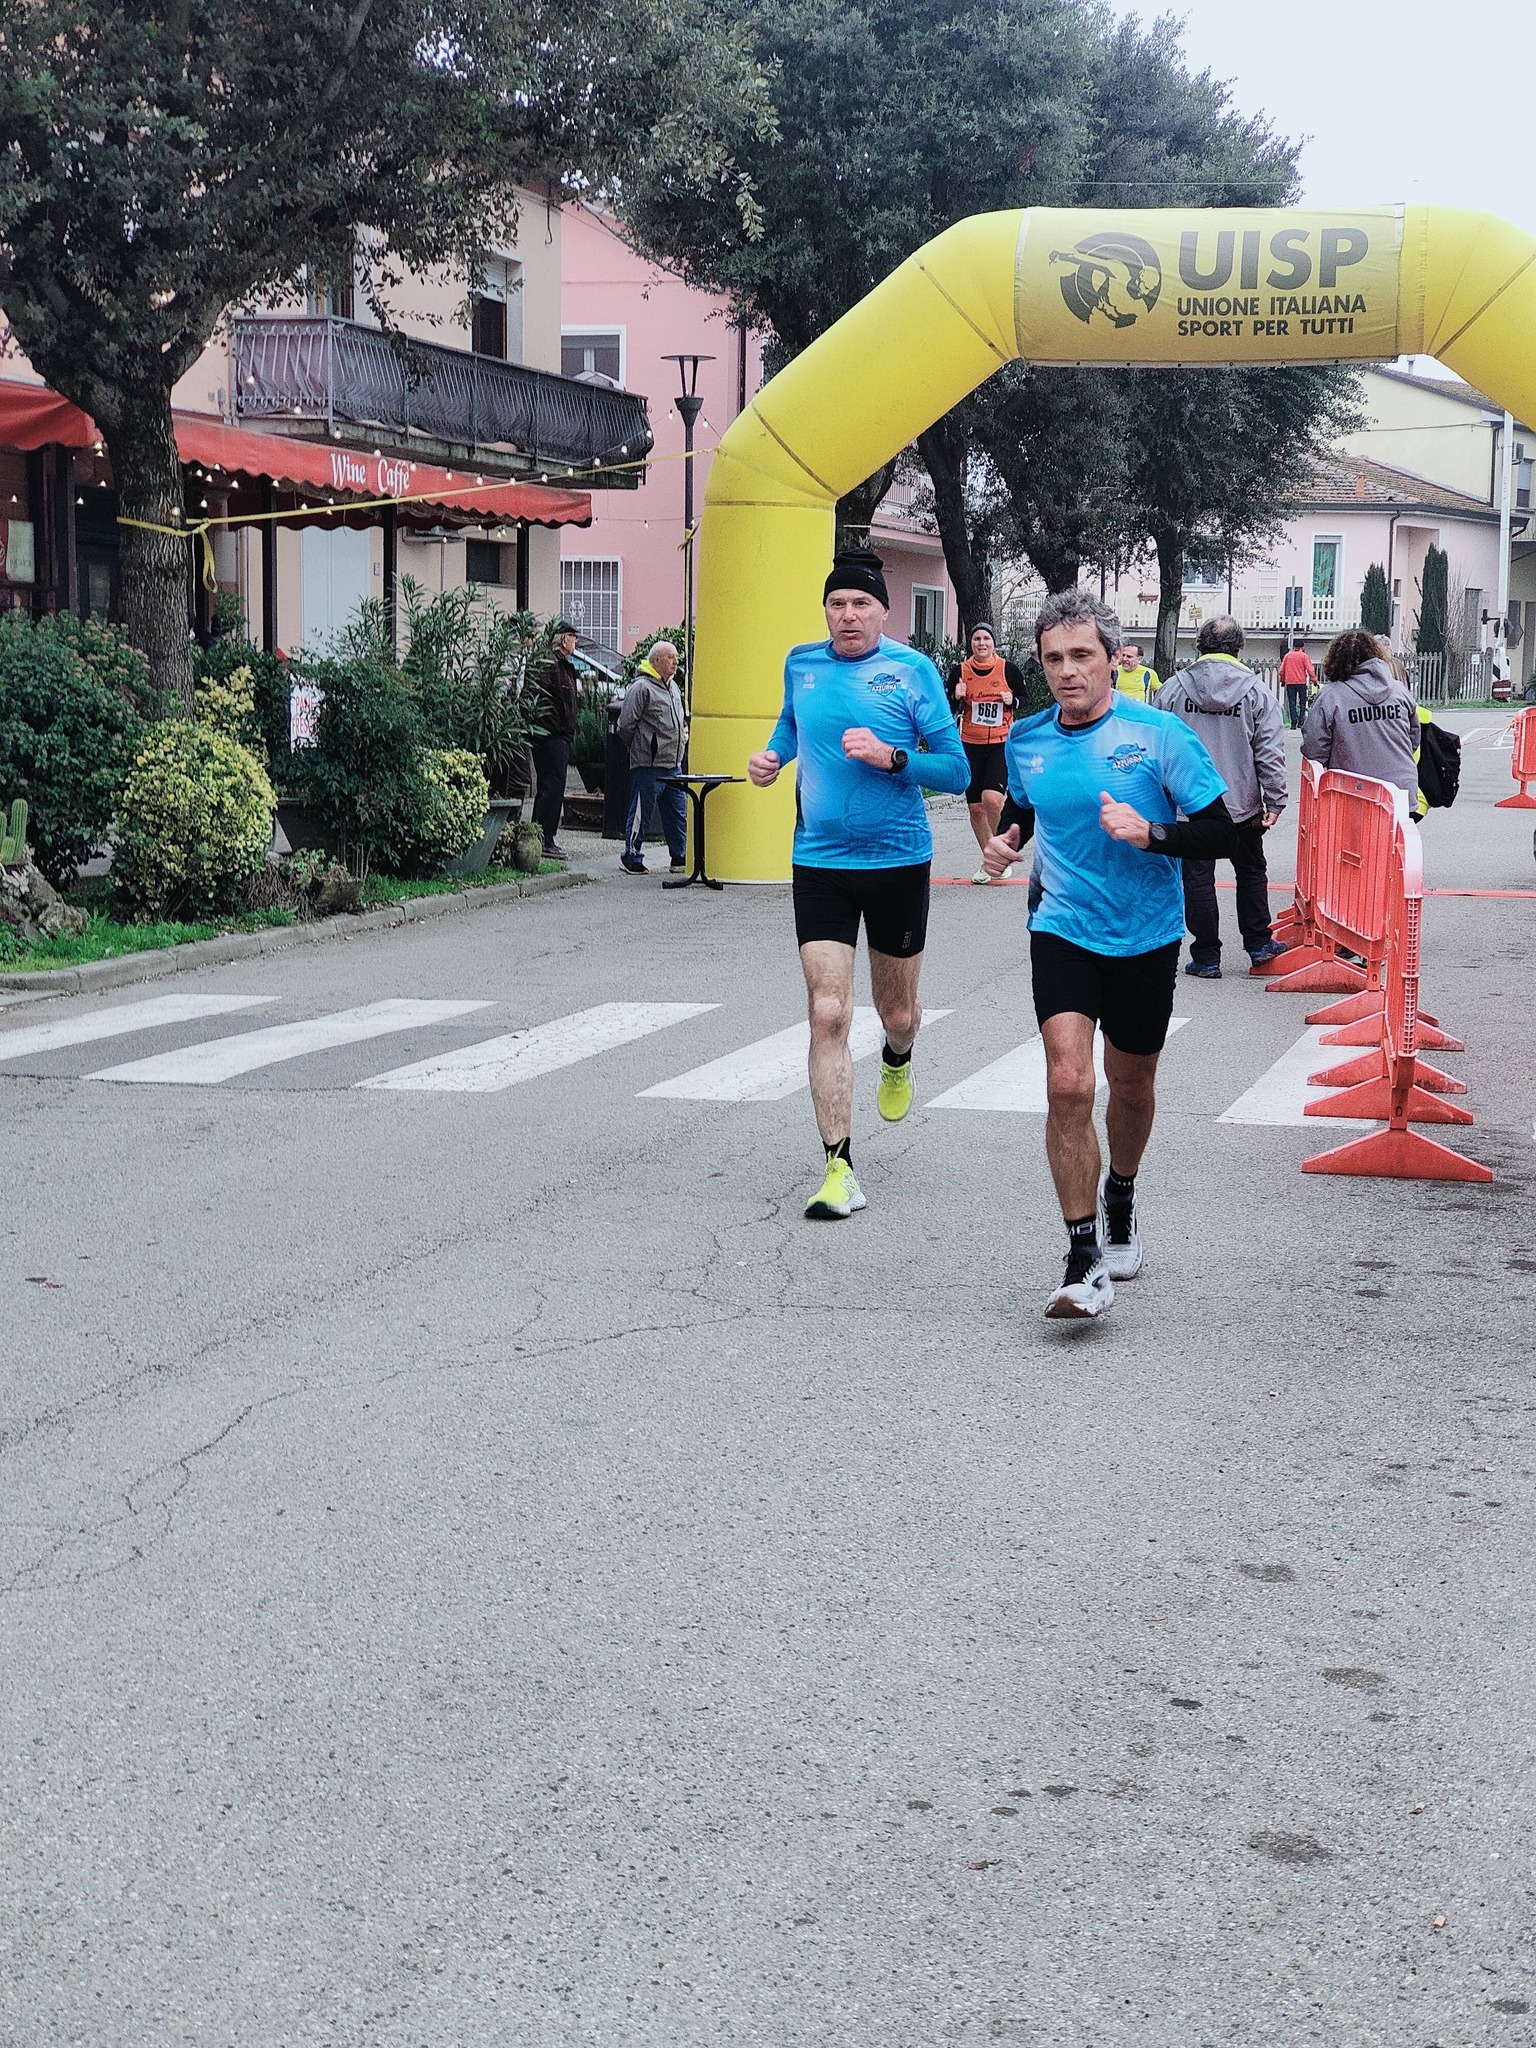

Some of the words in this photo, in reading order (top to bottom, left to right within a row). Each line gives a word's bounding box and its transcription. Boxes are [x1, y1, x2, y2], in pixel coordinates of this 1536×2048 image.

[1179, 228, 1369, 291] UISP
[1177, 297, 1260, 316] UNIONE
[1270, 294, 1367, 315] ITALIANA
[1178, 320, 1243, 336] SPORT
[1253, 319, 1289, 336] PER
[1300, 318, 1354, 335] TUTTI
[330, 453, 366, 488] Wine
[978, 702, 998, 718] 668
[1185, 697, 1242, 717] GICE
[1348, 704, 1401, 724] GIUDICE
